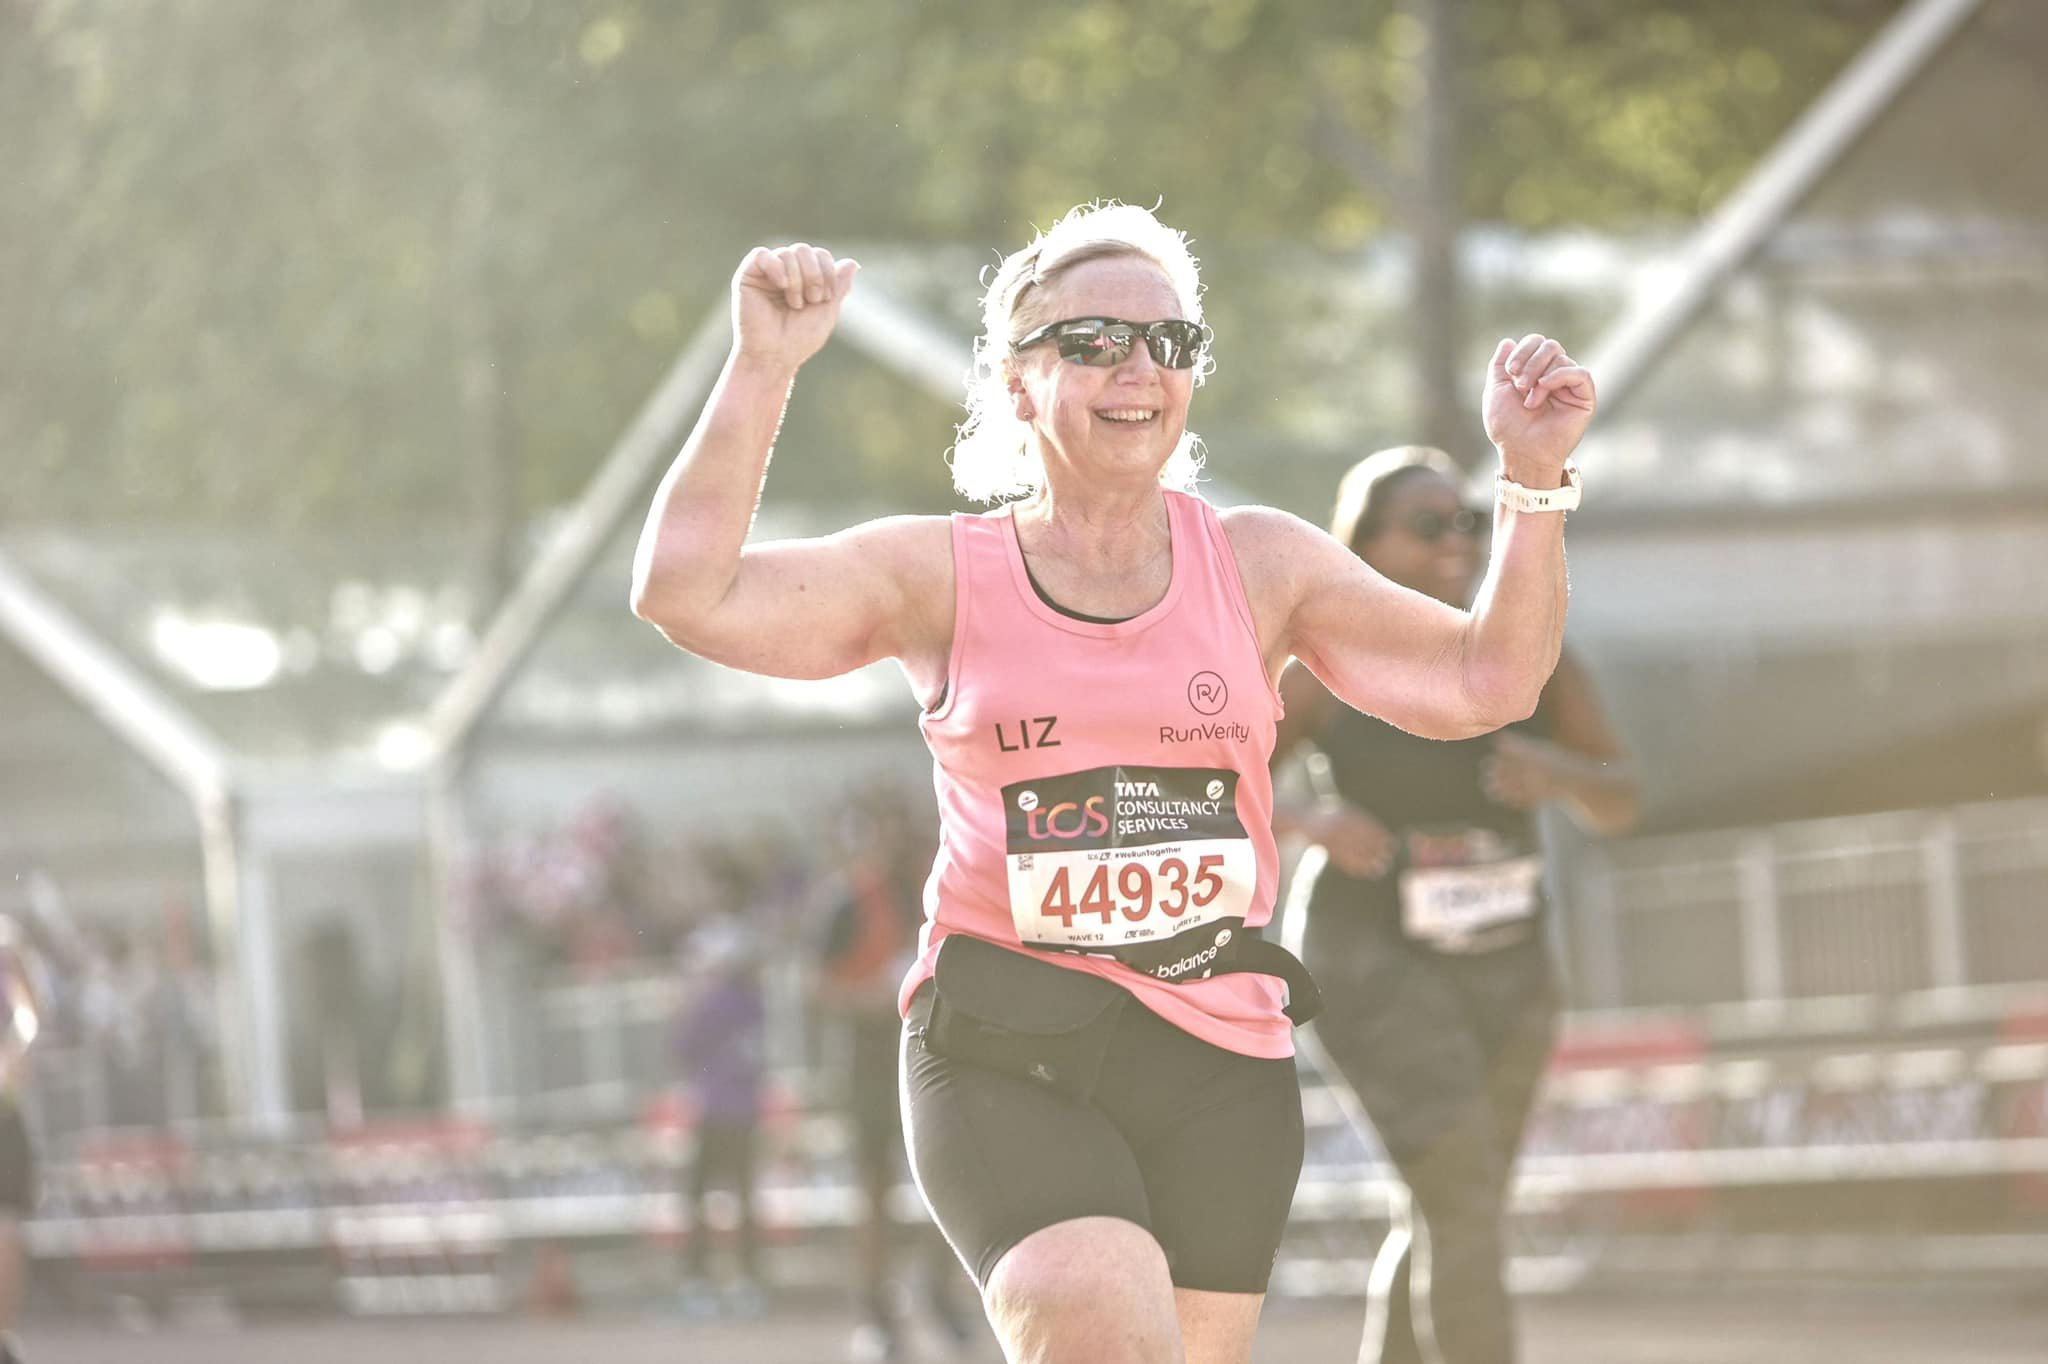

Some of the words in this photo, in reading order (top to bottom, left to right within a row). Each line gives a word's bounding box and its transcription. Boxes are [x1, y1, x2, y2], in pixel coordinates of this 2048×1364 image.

[995, 716, 1062, 753] LIZ
[1160, 721, 1250, 743] RunVerity
[1115, 782, 1160, 797] TATA
[1116, 801, 1221, 816] CONSULTANCY
[1118, 817, 1189, 835] SERVICES
[1115, 847, 1181, 859] #WeRunTogether
[1041, 855, 1225, 927] 44935
[1095, 933, 1104, 941] 12
[1157, 945, 1218, 979] balance
